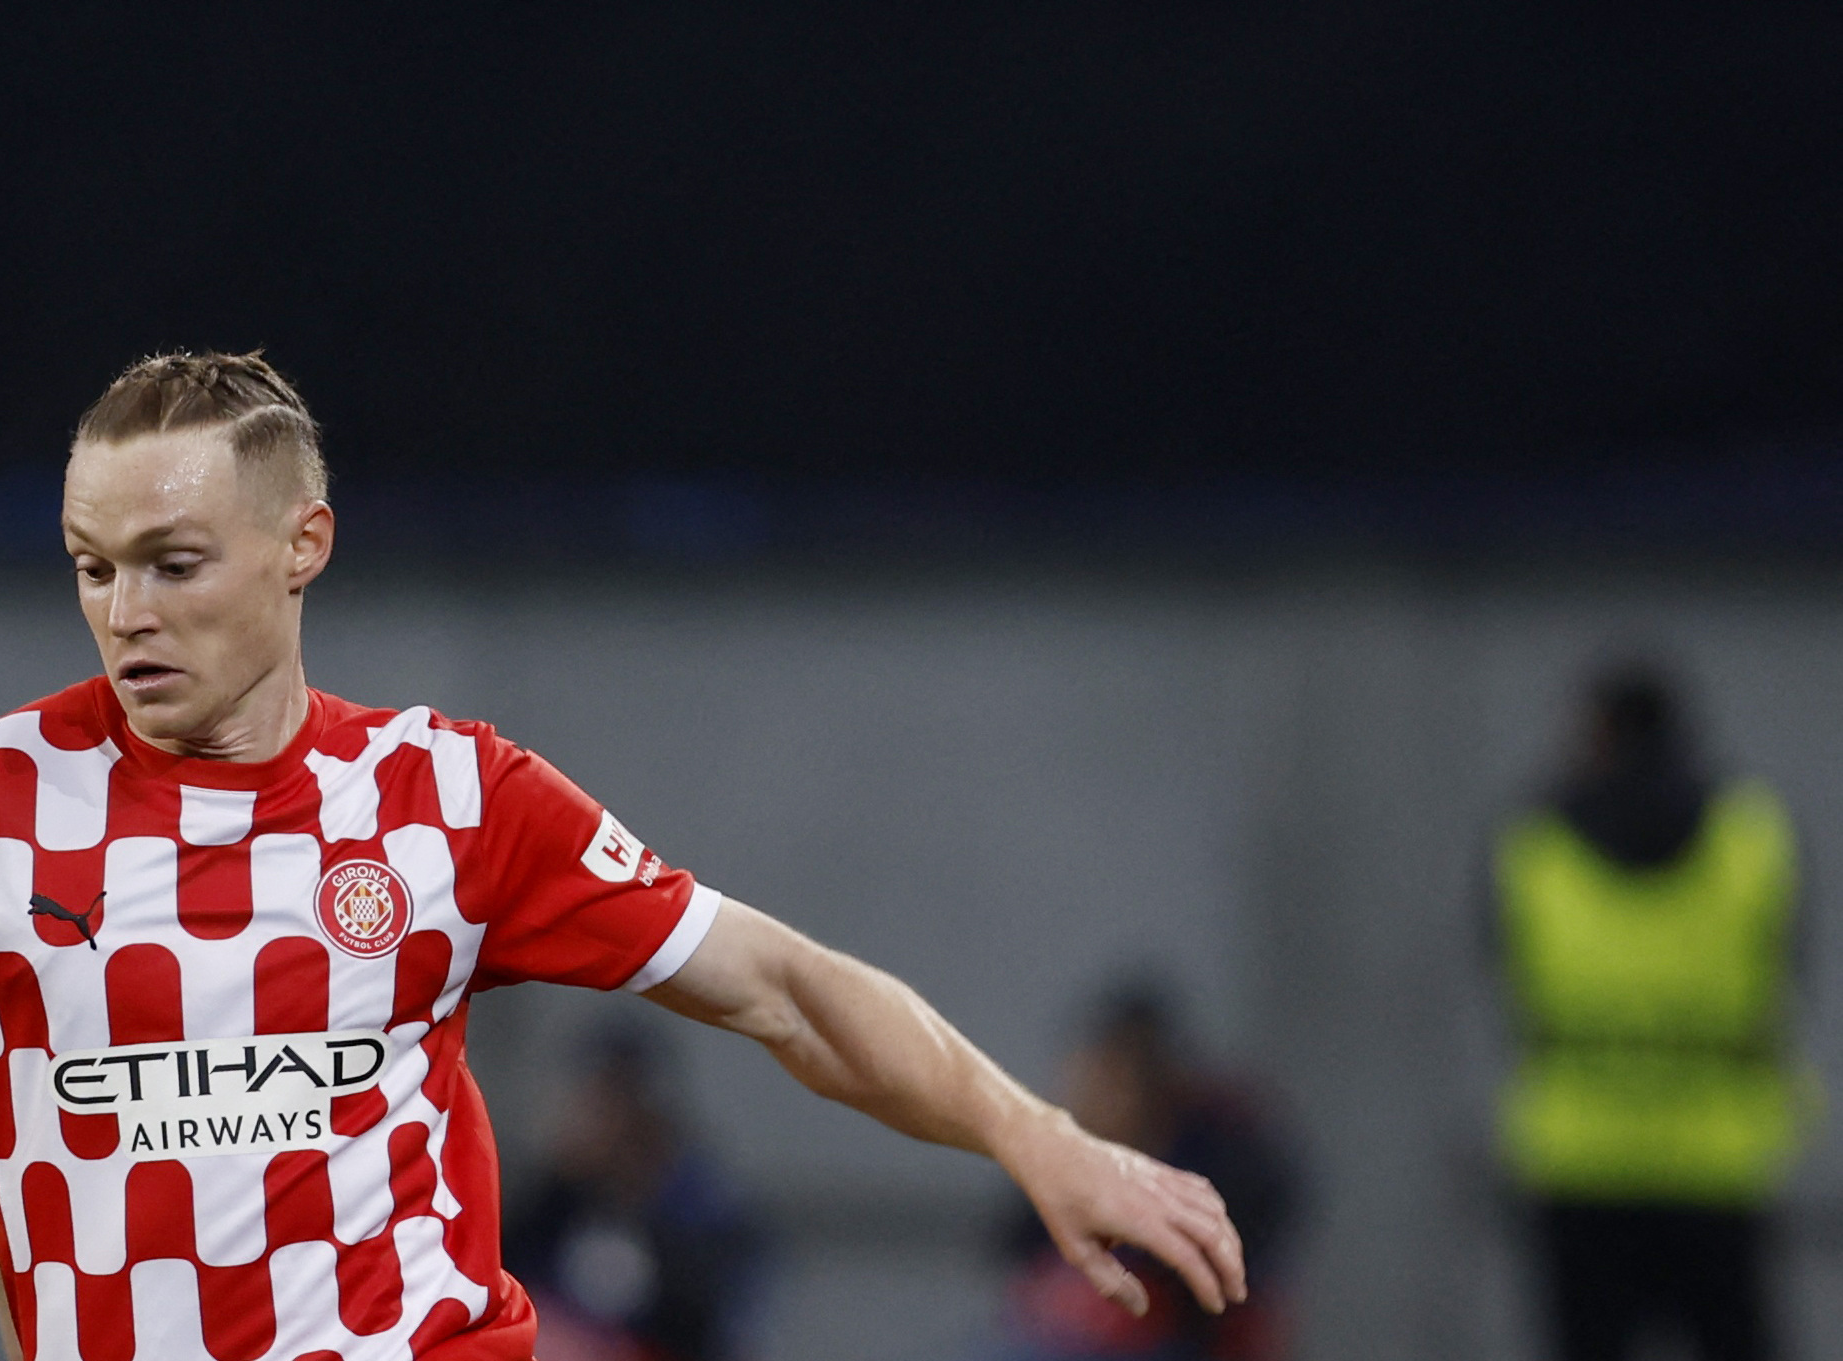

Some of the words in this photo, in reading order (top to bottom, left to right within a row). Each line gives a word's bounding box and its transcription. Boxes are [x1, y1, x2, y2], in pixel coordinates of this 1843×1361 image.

[332, 866, 390, 888] GIRONA
[338, 932, 372, 949] FUTBOL
[374, 931, 395, 948] CLUB
[53, 1038, 385, 1105] ETIHAD
[131, 1110, 322, 1152] AIRWAYS
